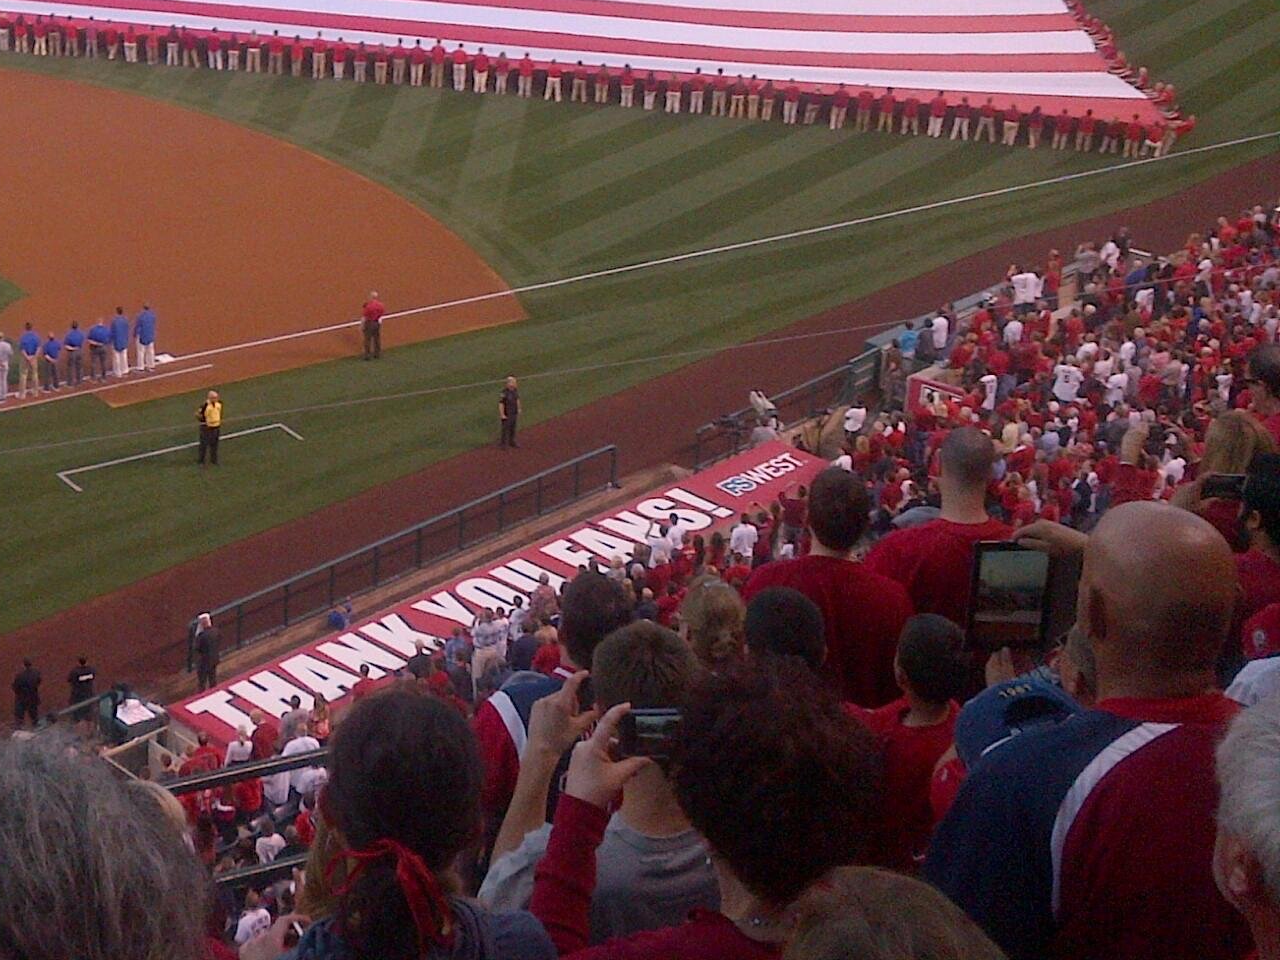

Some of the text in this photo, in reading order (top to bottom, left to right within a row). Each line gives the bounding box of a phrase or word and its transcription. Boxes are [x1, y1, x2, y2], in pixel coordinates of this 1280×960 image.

[184, 488, 735, 738] THANK YOU FANS!
